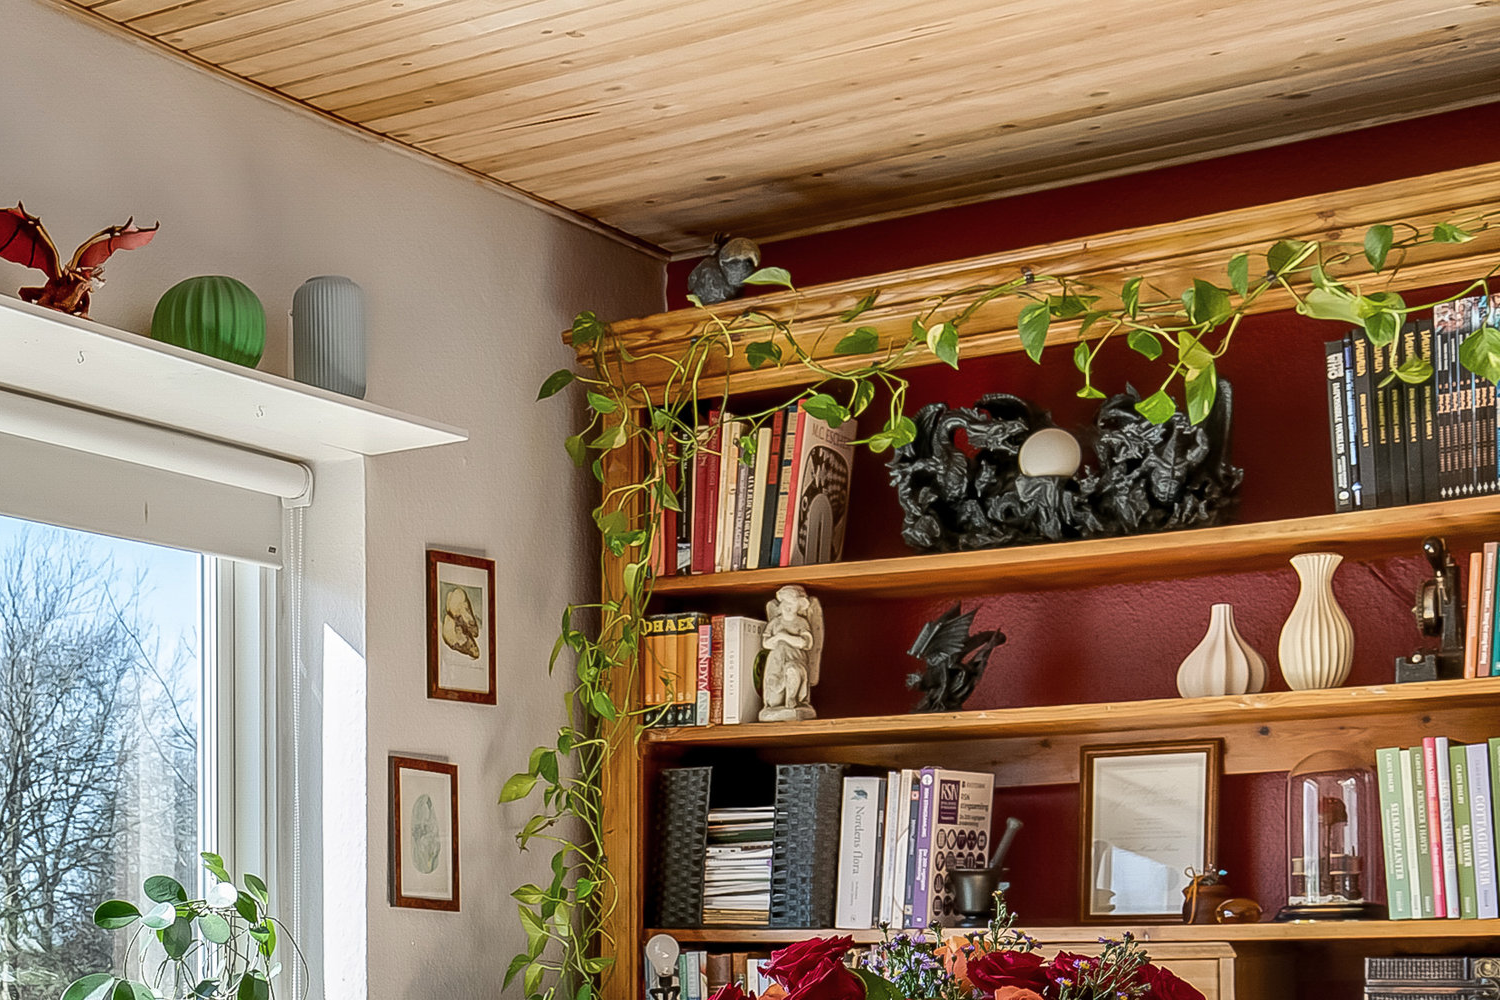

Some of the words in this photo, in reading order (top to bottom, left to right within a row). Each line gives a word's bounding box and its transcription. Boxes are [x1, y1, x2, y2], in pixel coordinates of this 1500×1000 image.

[698, 635, 710, 713] HANDYMAN
[940, 783, 959, 801] RSN
[853, 806, 865, 848] Nordens
[1389, 802, 1404, 880] SELSKABSPLANTER
[1475, 795, 1491, 885] COTTAGEHAVER
[852, 851, 863, 875] flora
